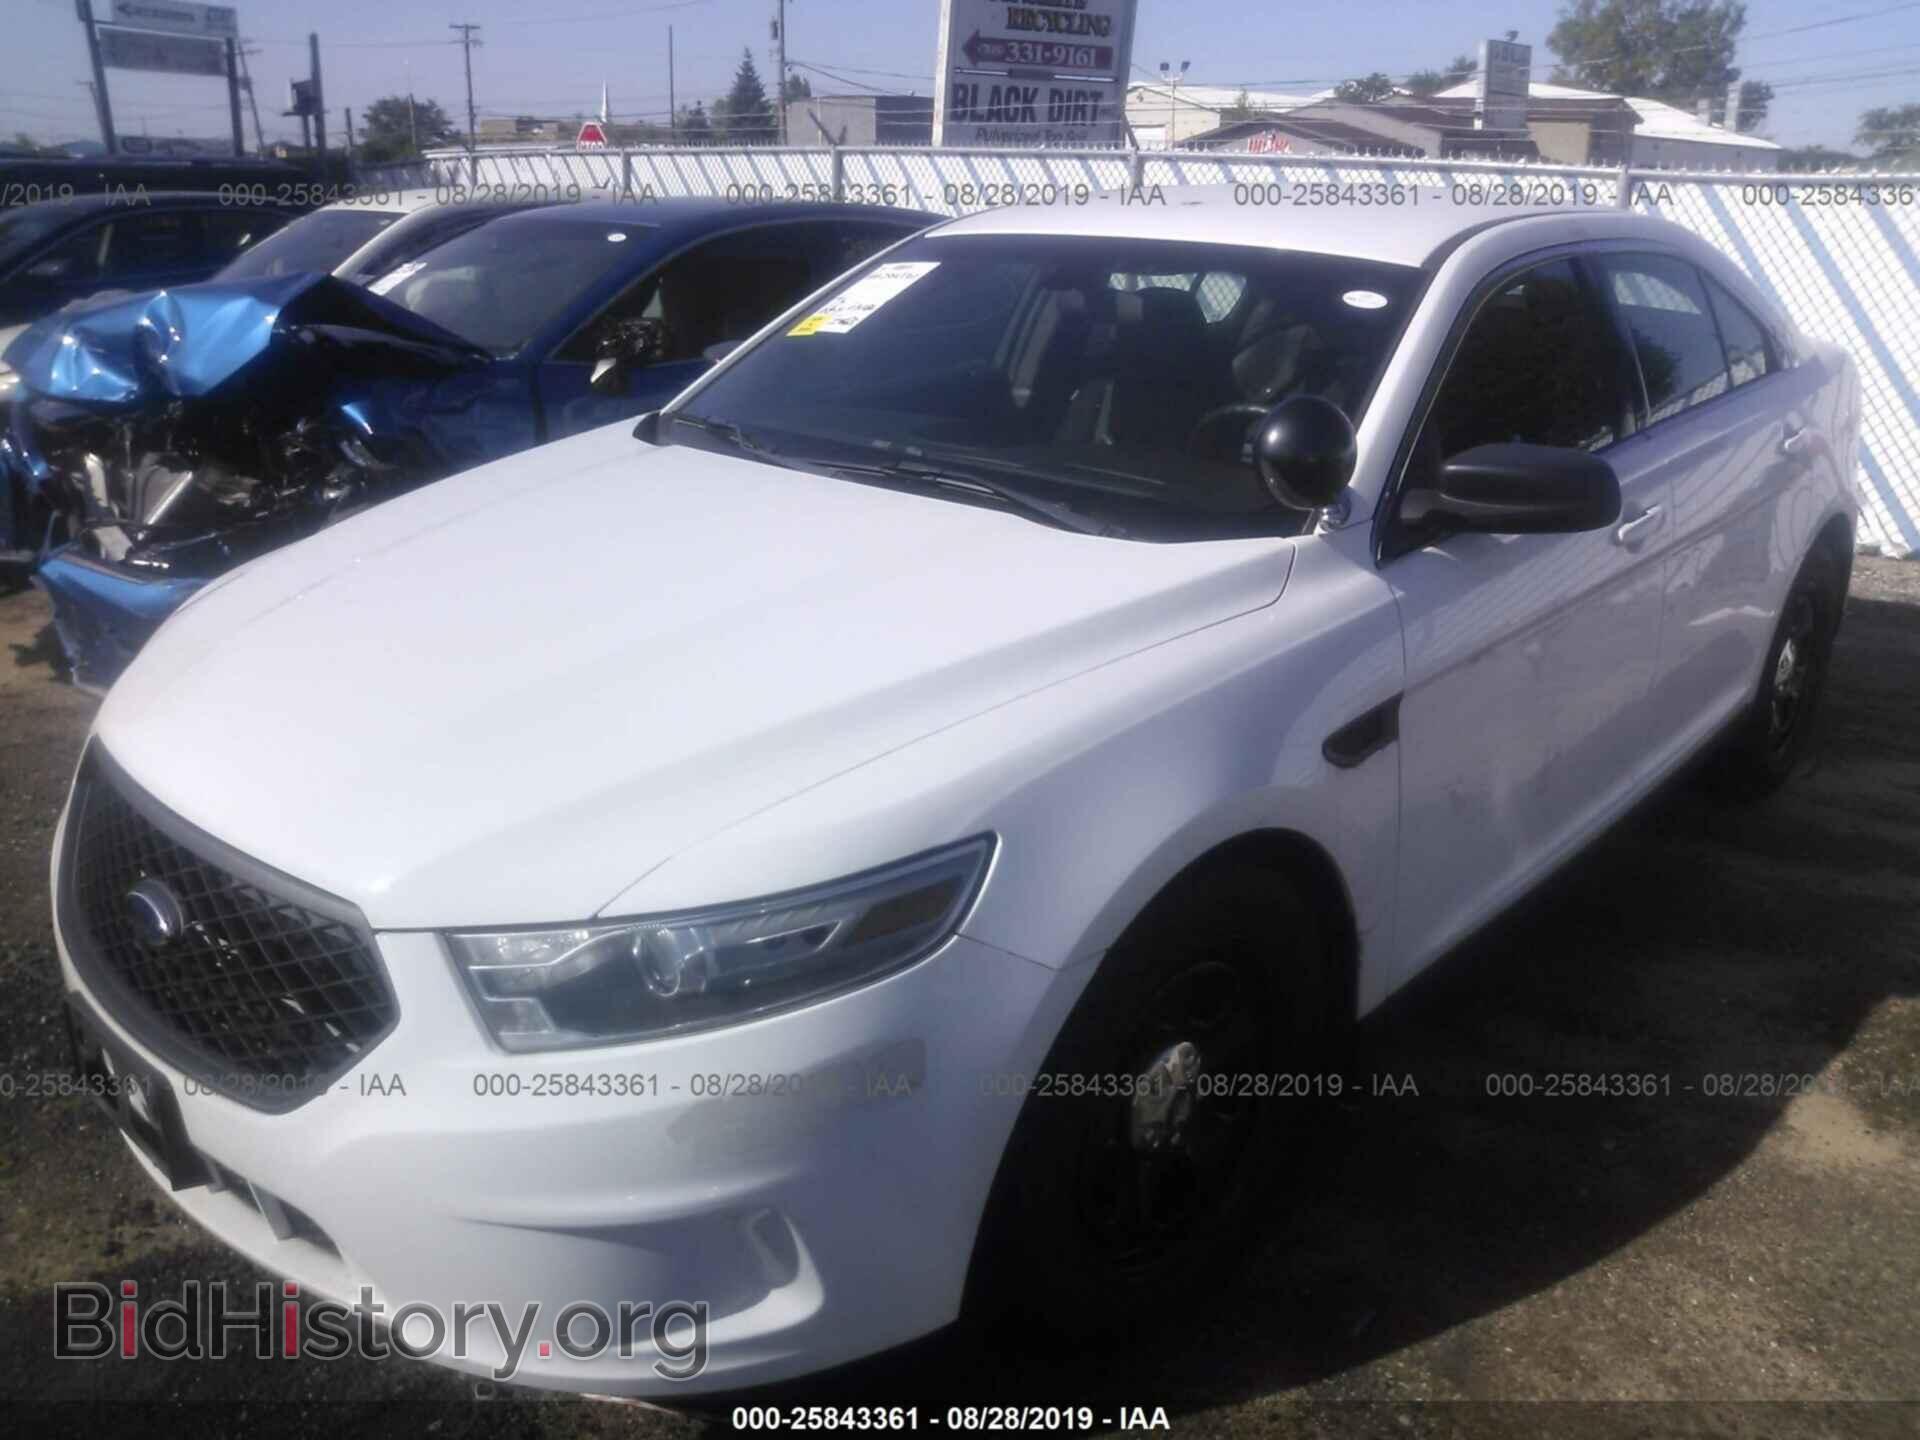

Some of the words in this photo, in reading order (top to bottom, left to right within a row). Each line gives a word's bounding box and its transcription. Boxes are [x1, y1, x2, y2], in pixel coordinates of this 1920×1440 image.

[1006, 6, 1112, 37] RECYCLING
[1005, 42, 1097, 67] 331-9161
[951, 83, 1039, 123] BLACK
[1048, 88, 1104, 127] DIRT
